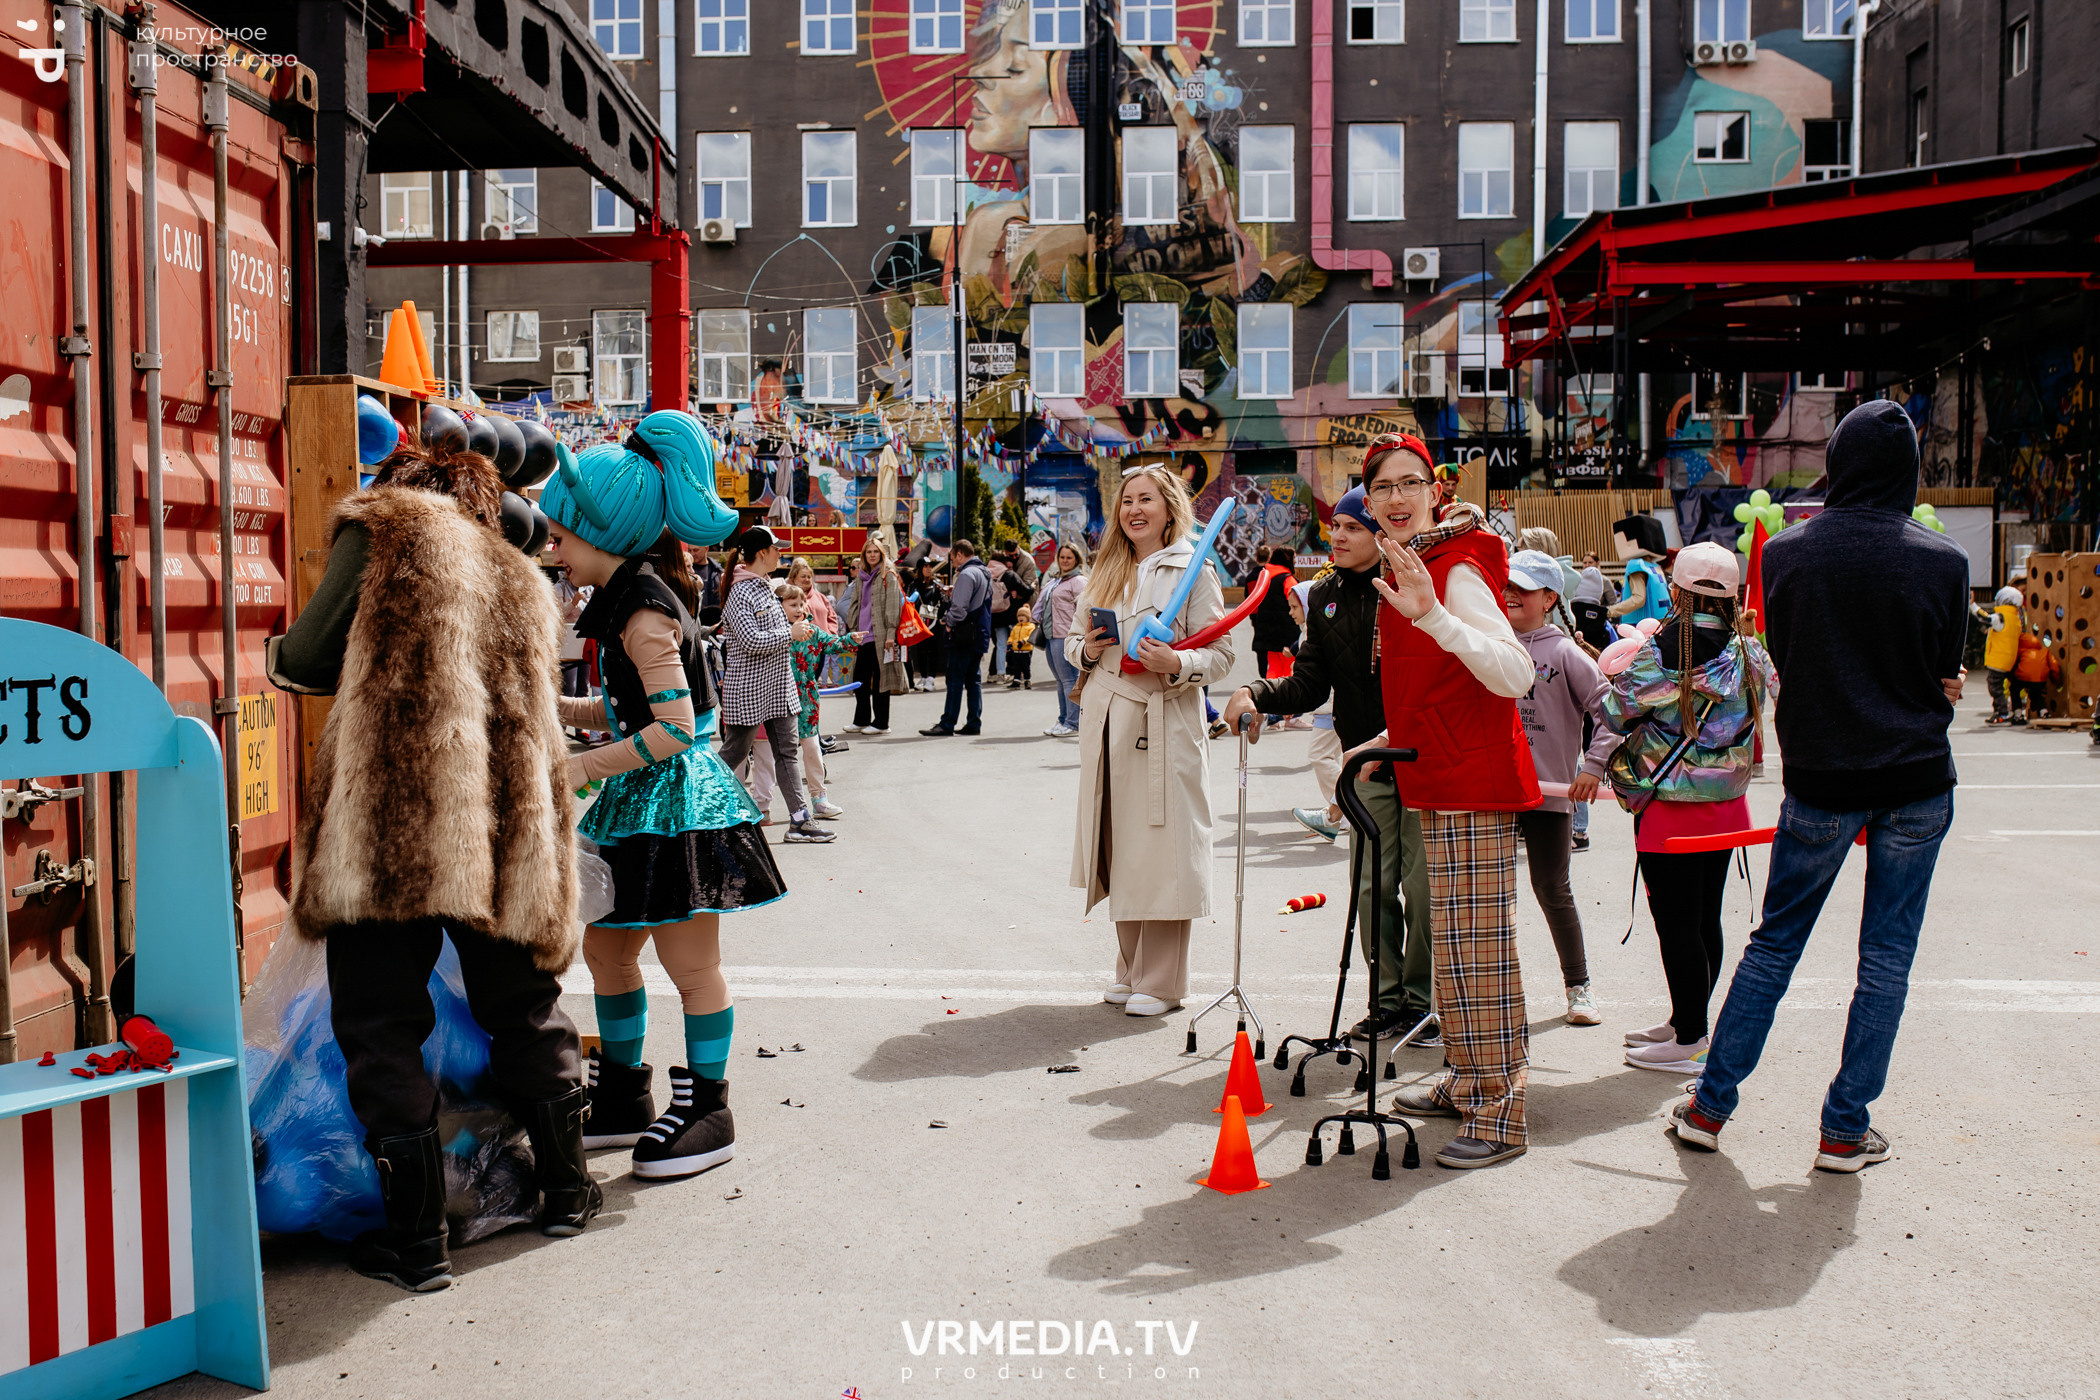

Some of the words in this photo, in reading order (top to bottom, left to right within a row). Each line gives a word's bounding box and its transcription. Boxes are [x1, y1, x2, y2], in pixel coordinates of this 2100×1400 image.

[162, 223, 202, 272] CAXU
[282, 266, 290, 303] 3
[969, 344, 986, 354] MAN
[1001, 343, 1015, 354] THE
[993, 354, 1015, 364] MOON
[175, 403, 202, 424] GROSS
[256, 488, 271, 507] LBS.
[245, 779, 269, 815] HIGH
